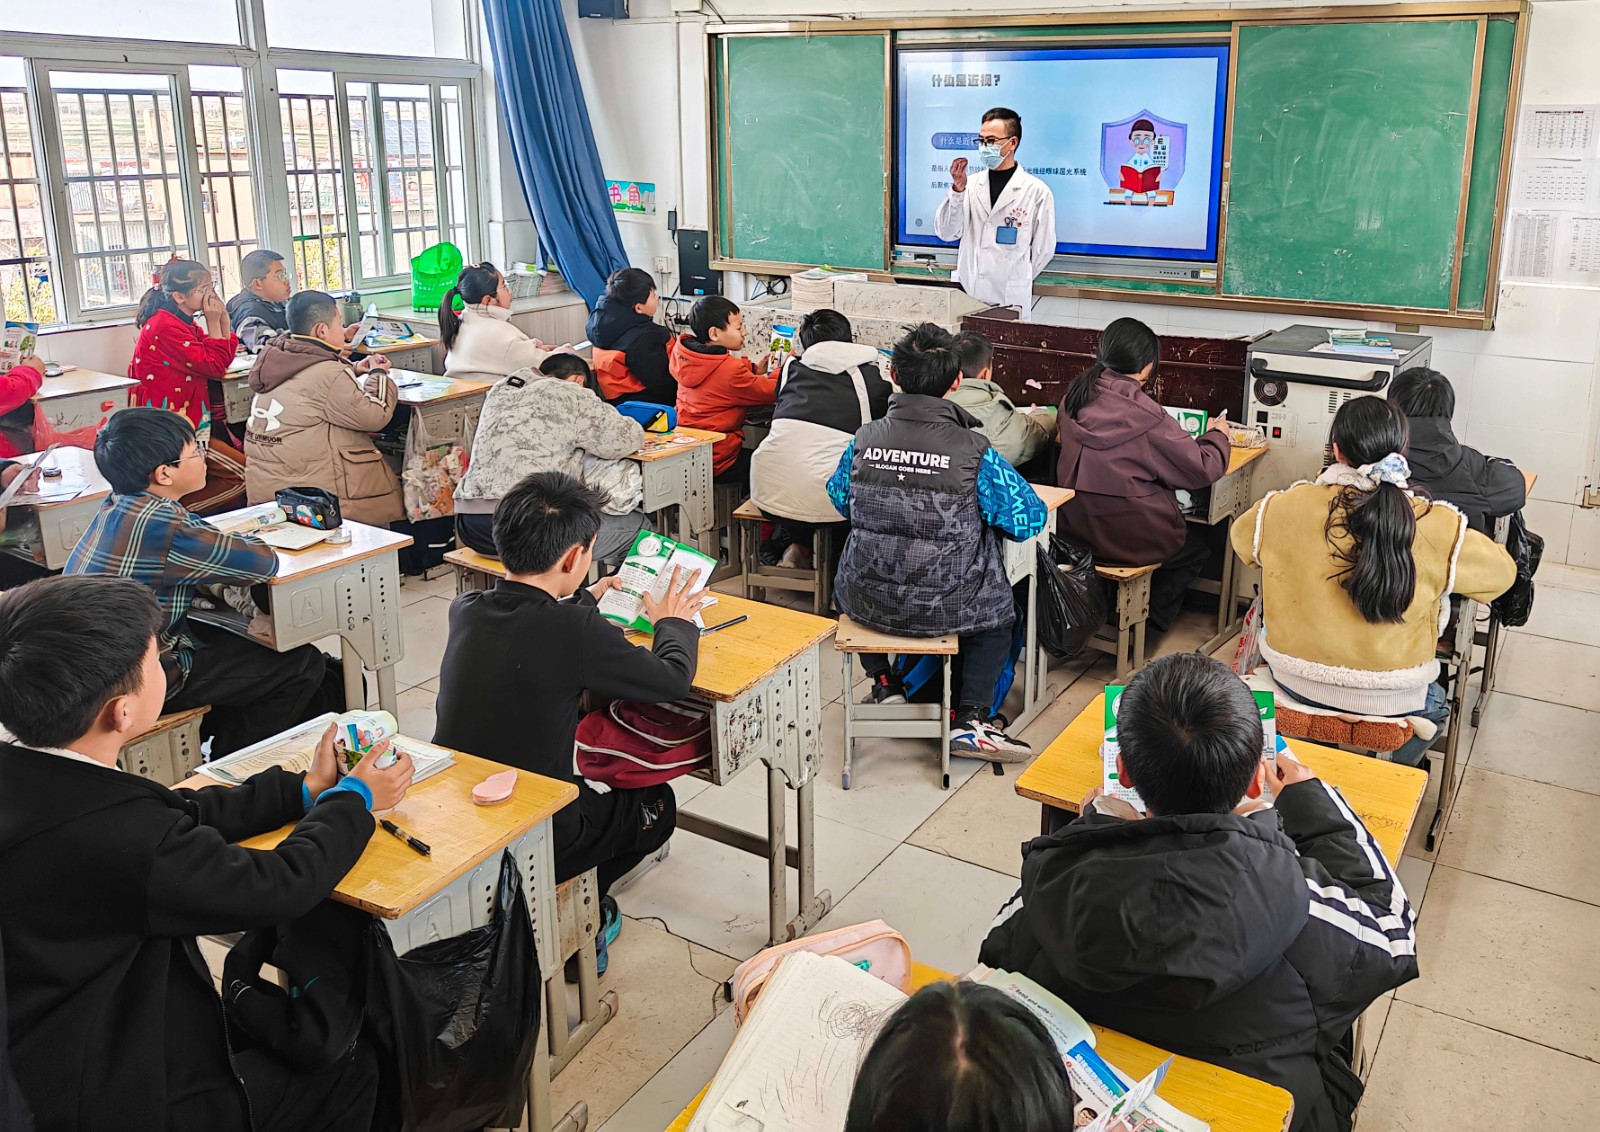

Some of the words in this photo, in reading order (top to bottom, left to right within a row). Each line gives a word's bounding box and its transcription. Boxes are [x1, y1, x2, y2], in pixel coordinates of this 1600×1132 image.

[862, 447, 951, 469] ADVENTURE
[875, 463, 898, 471] SLOGAN
[898, 465, 914, 473] GOES
[915, 467, 932, 475] HERE
[1003, 468, 1028, 536] CAMEL
